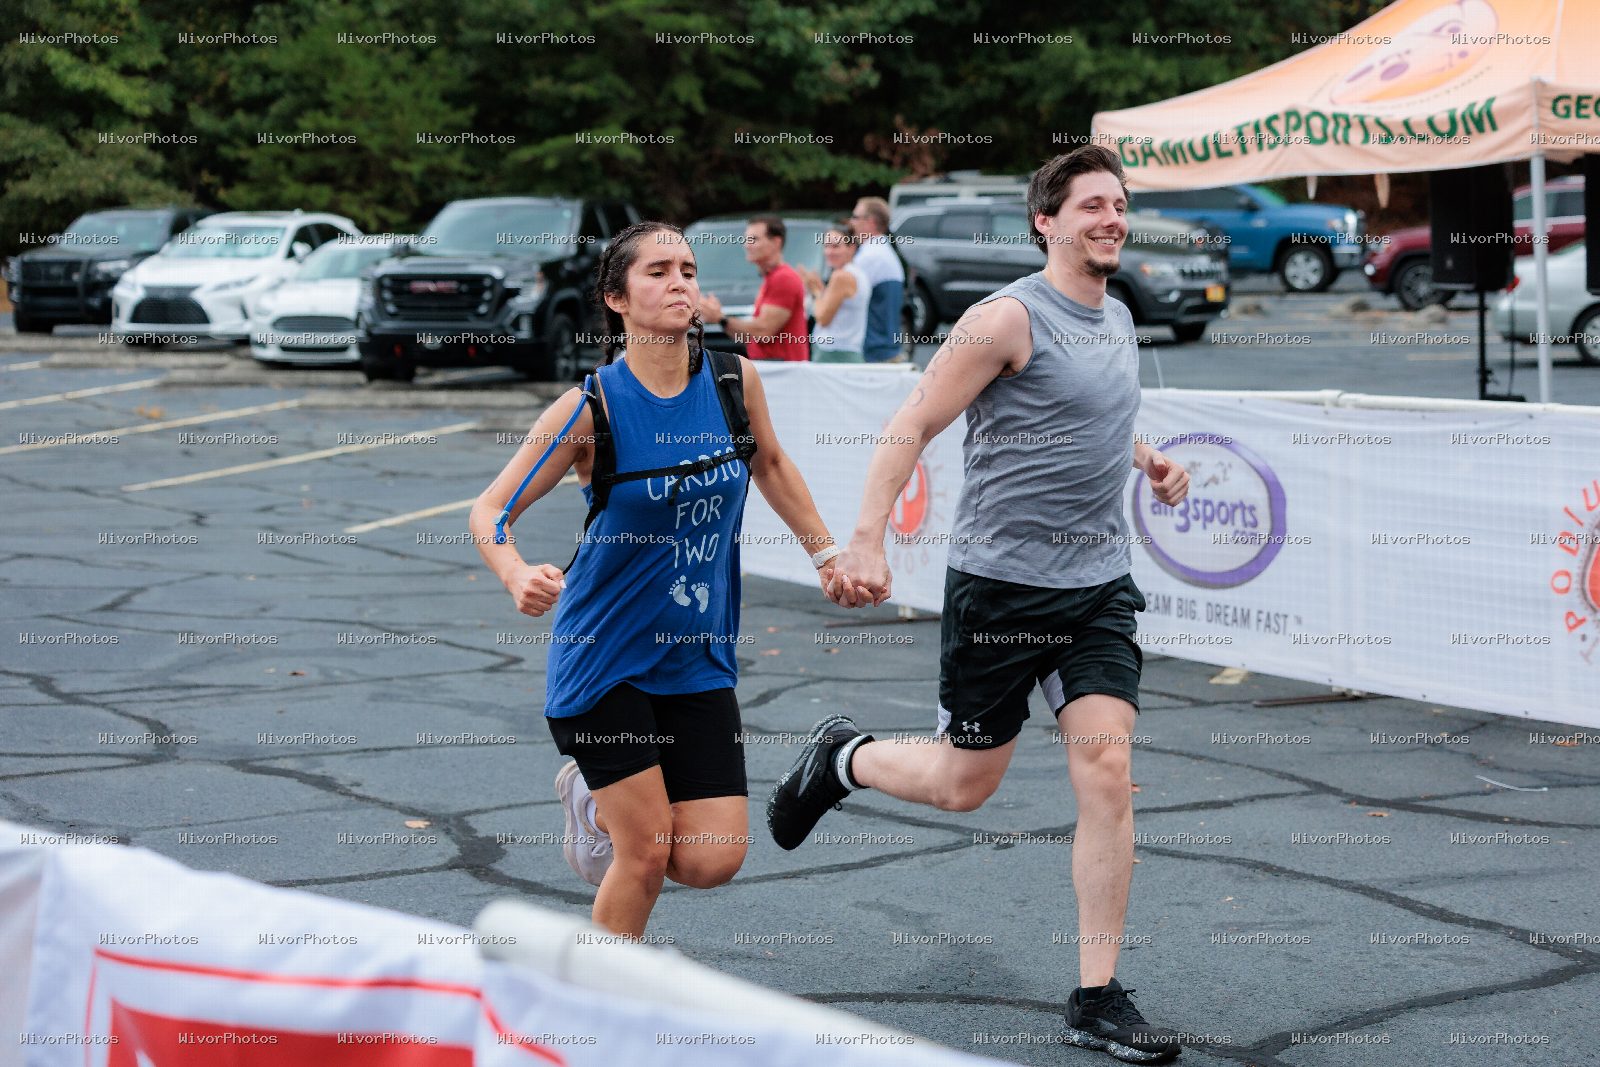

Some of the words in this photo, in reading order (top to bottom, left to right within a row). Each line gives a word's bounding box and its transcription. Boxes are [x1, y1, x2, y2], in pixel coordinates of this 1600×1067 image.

[1551, 94, 1600, 119] GE
[675, 494, 723, 530] FOR
[672, 533, 720, 569] TWO
[1550, 479, 1600, 633] PODIU
[1145, 592, 1171, 616] EAM
[1206, 601, 1251, 630] DREAM
